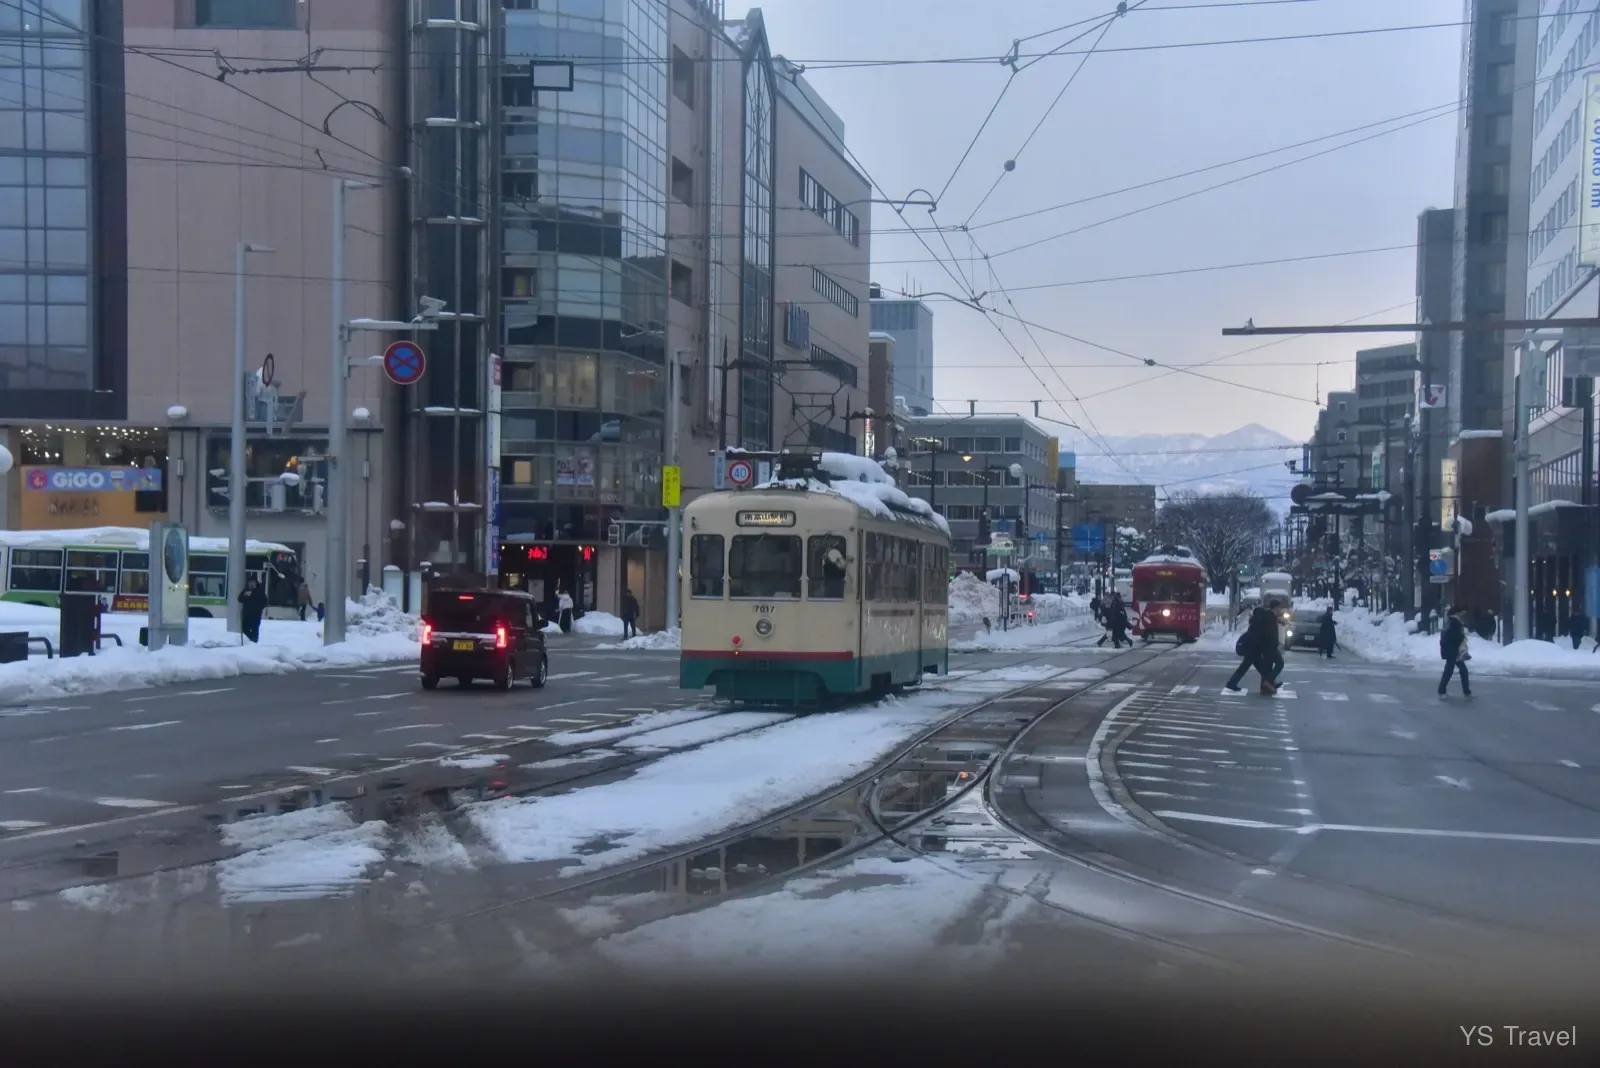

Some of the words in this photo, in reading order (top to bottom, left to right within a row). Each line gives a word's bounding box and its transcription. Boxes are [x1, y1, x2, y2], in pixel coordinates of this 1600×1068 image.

[734, 467, 747, 478] 40
[52, 472, 104, 488] GiGO
[754, 605, 775, 613] 7017
